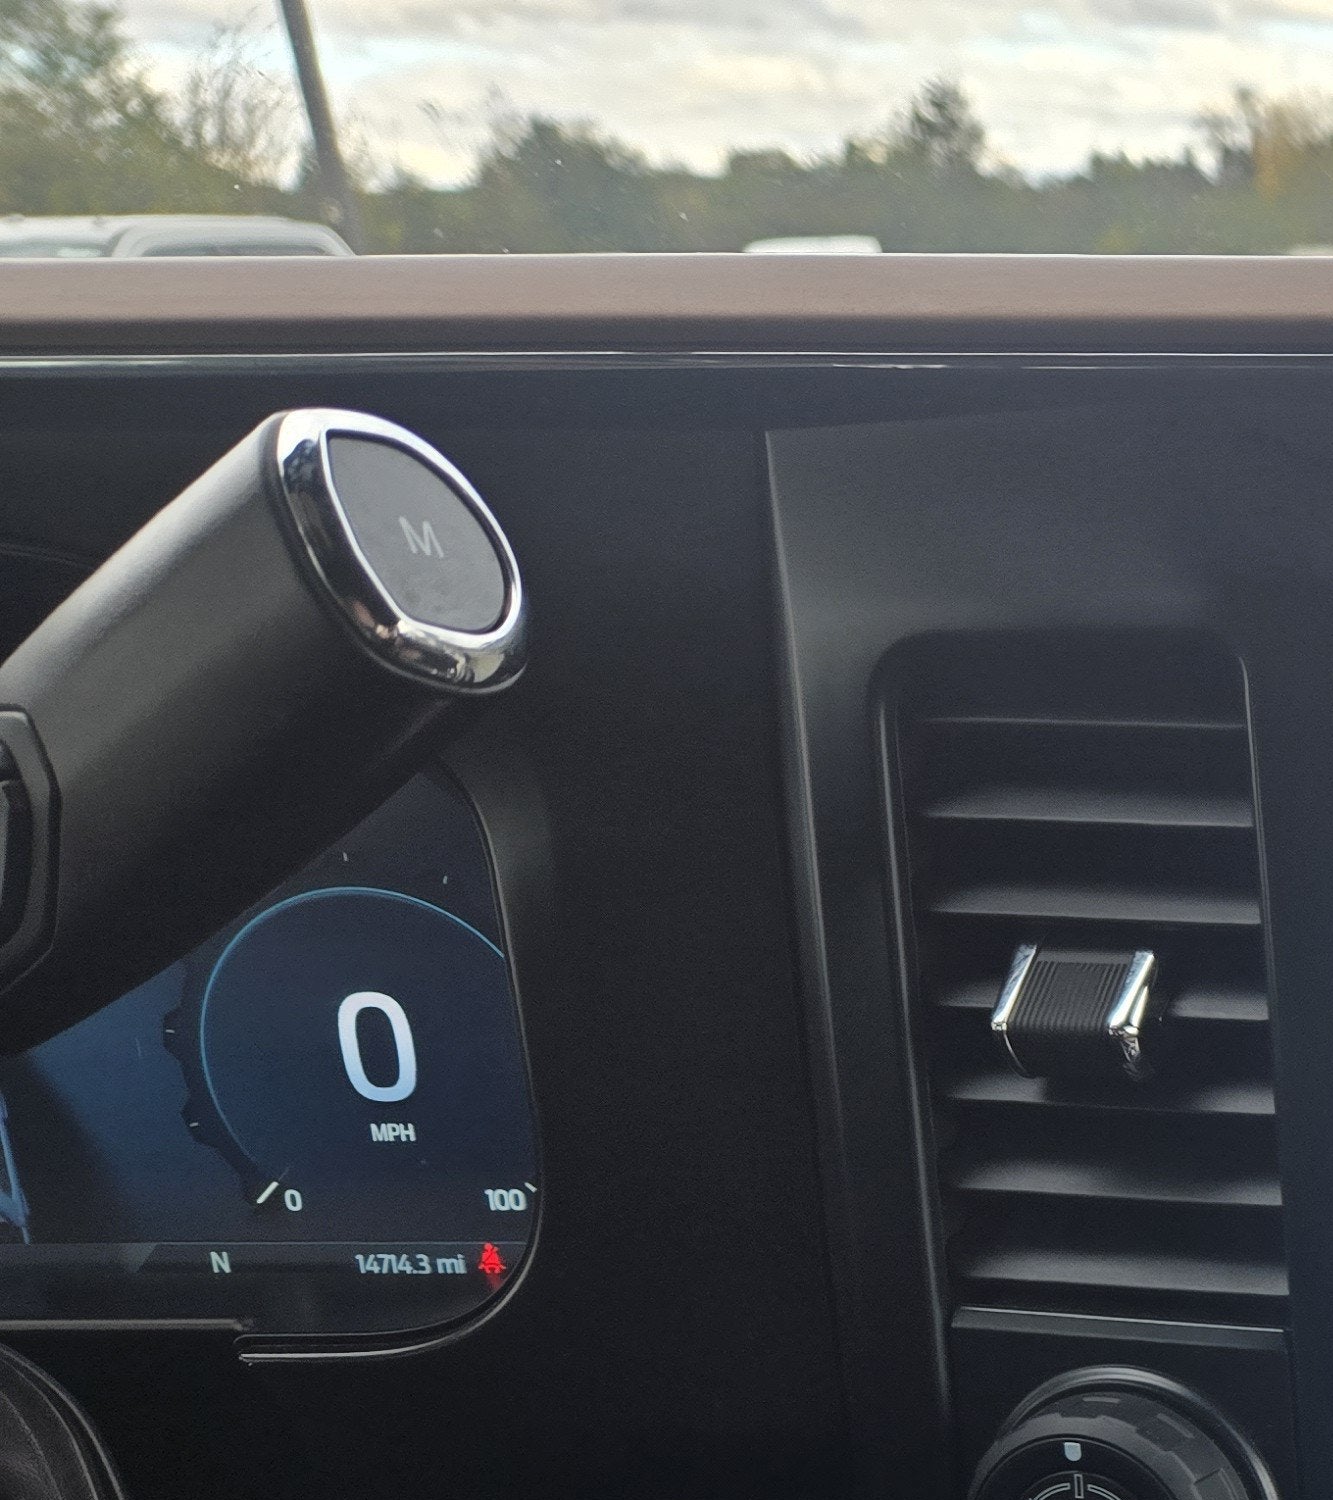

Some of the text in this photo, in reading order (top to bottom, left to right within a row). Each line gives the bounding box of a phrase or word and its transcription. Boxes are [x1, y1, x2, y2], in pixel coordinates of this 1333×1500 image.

[399, 517, 444, 558] M
[338, 991, 416, 1102] 0
[370, 1123, 416, 1141] MPH
[284, 1189, 302, 1211] 0
[484, 1189, 527, 1212] 100
[210, 1251, 231, 1273] N
[353, 1253, 466, 1276] 14714.3 mi
